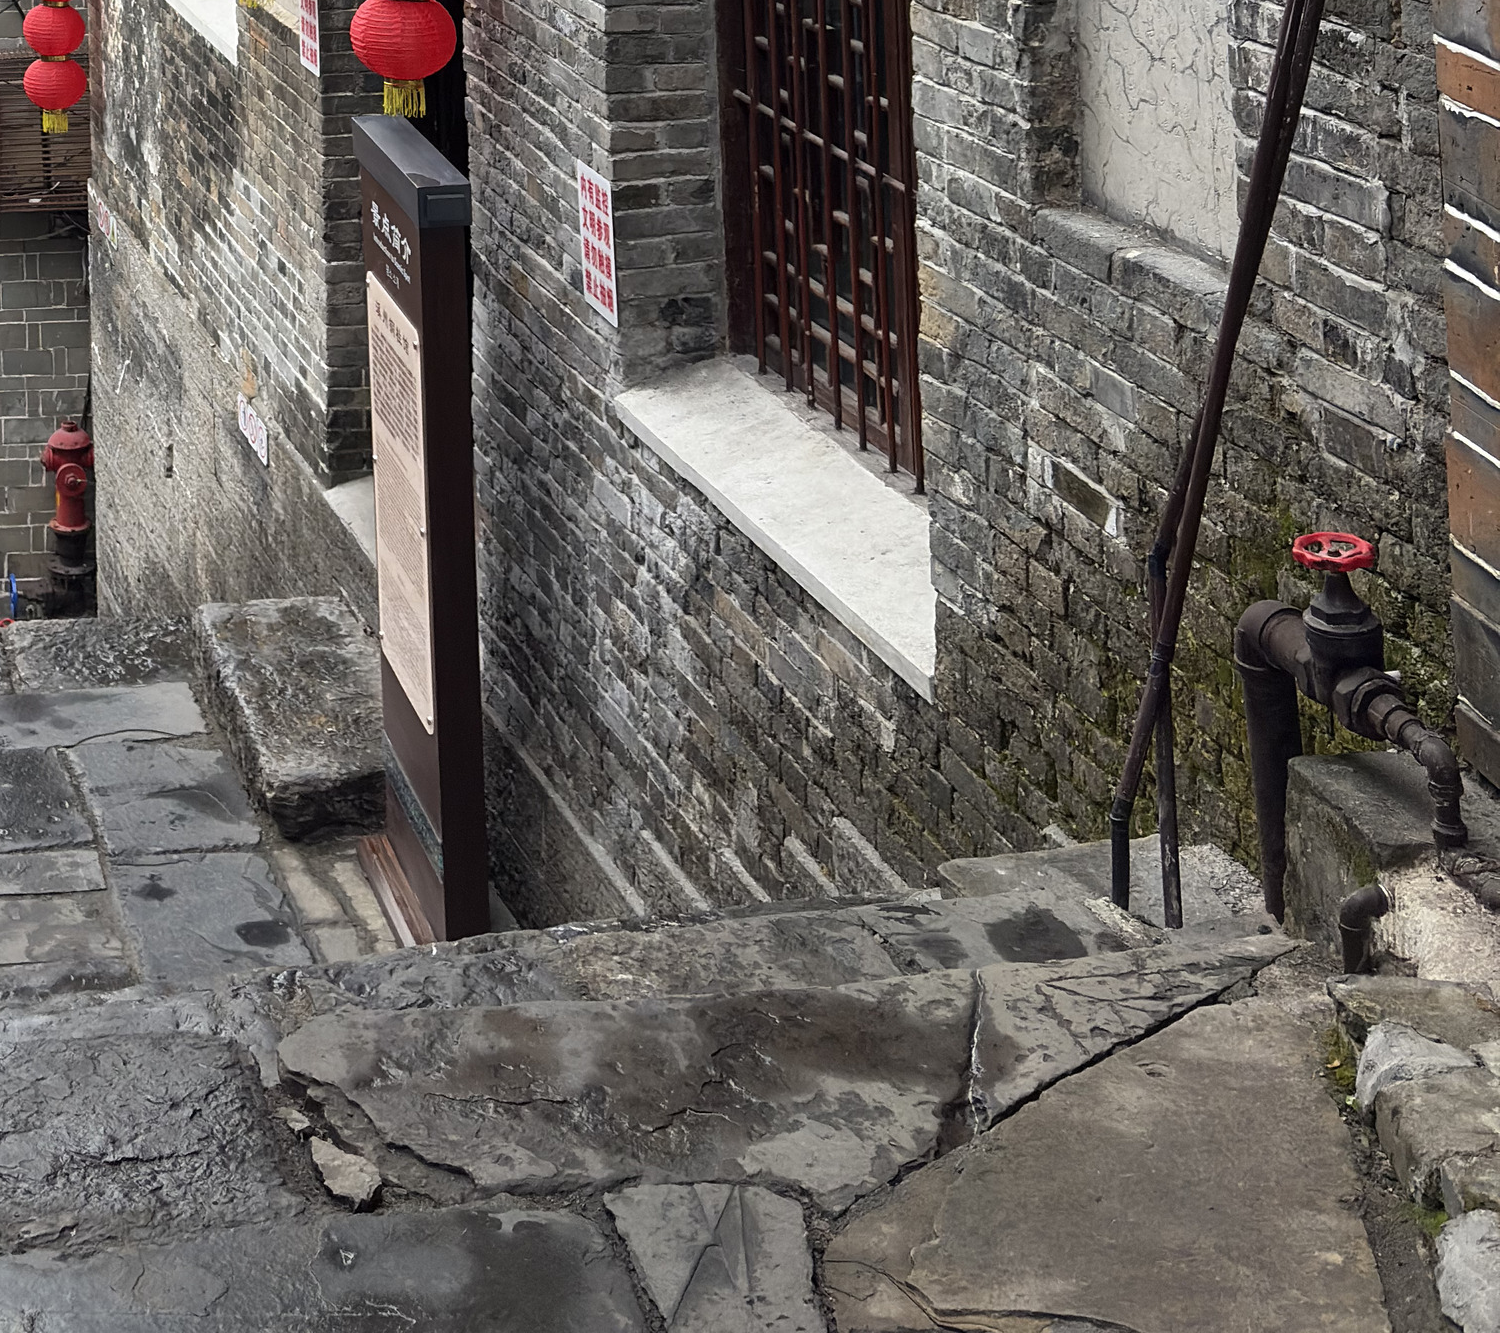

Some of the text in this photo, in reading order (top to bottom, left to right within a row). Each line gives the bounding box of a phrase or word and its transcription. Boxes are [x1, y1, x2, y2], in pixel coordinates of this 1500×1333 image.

[580, 172, 610, 218] 内有监控
[370, 199, 412, 265] 景点简介
[581, 205, 612, 251] 文明参观
[583, 236, 613, 282] 请勿触摸
